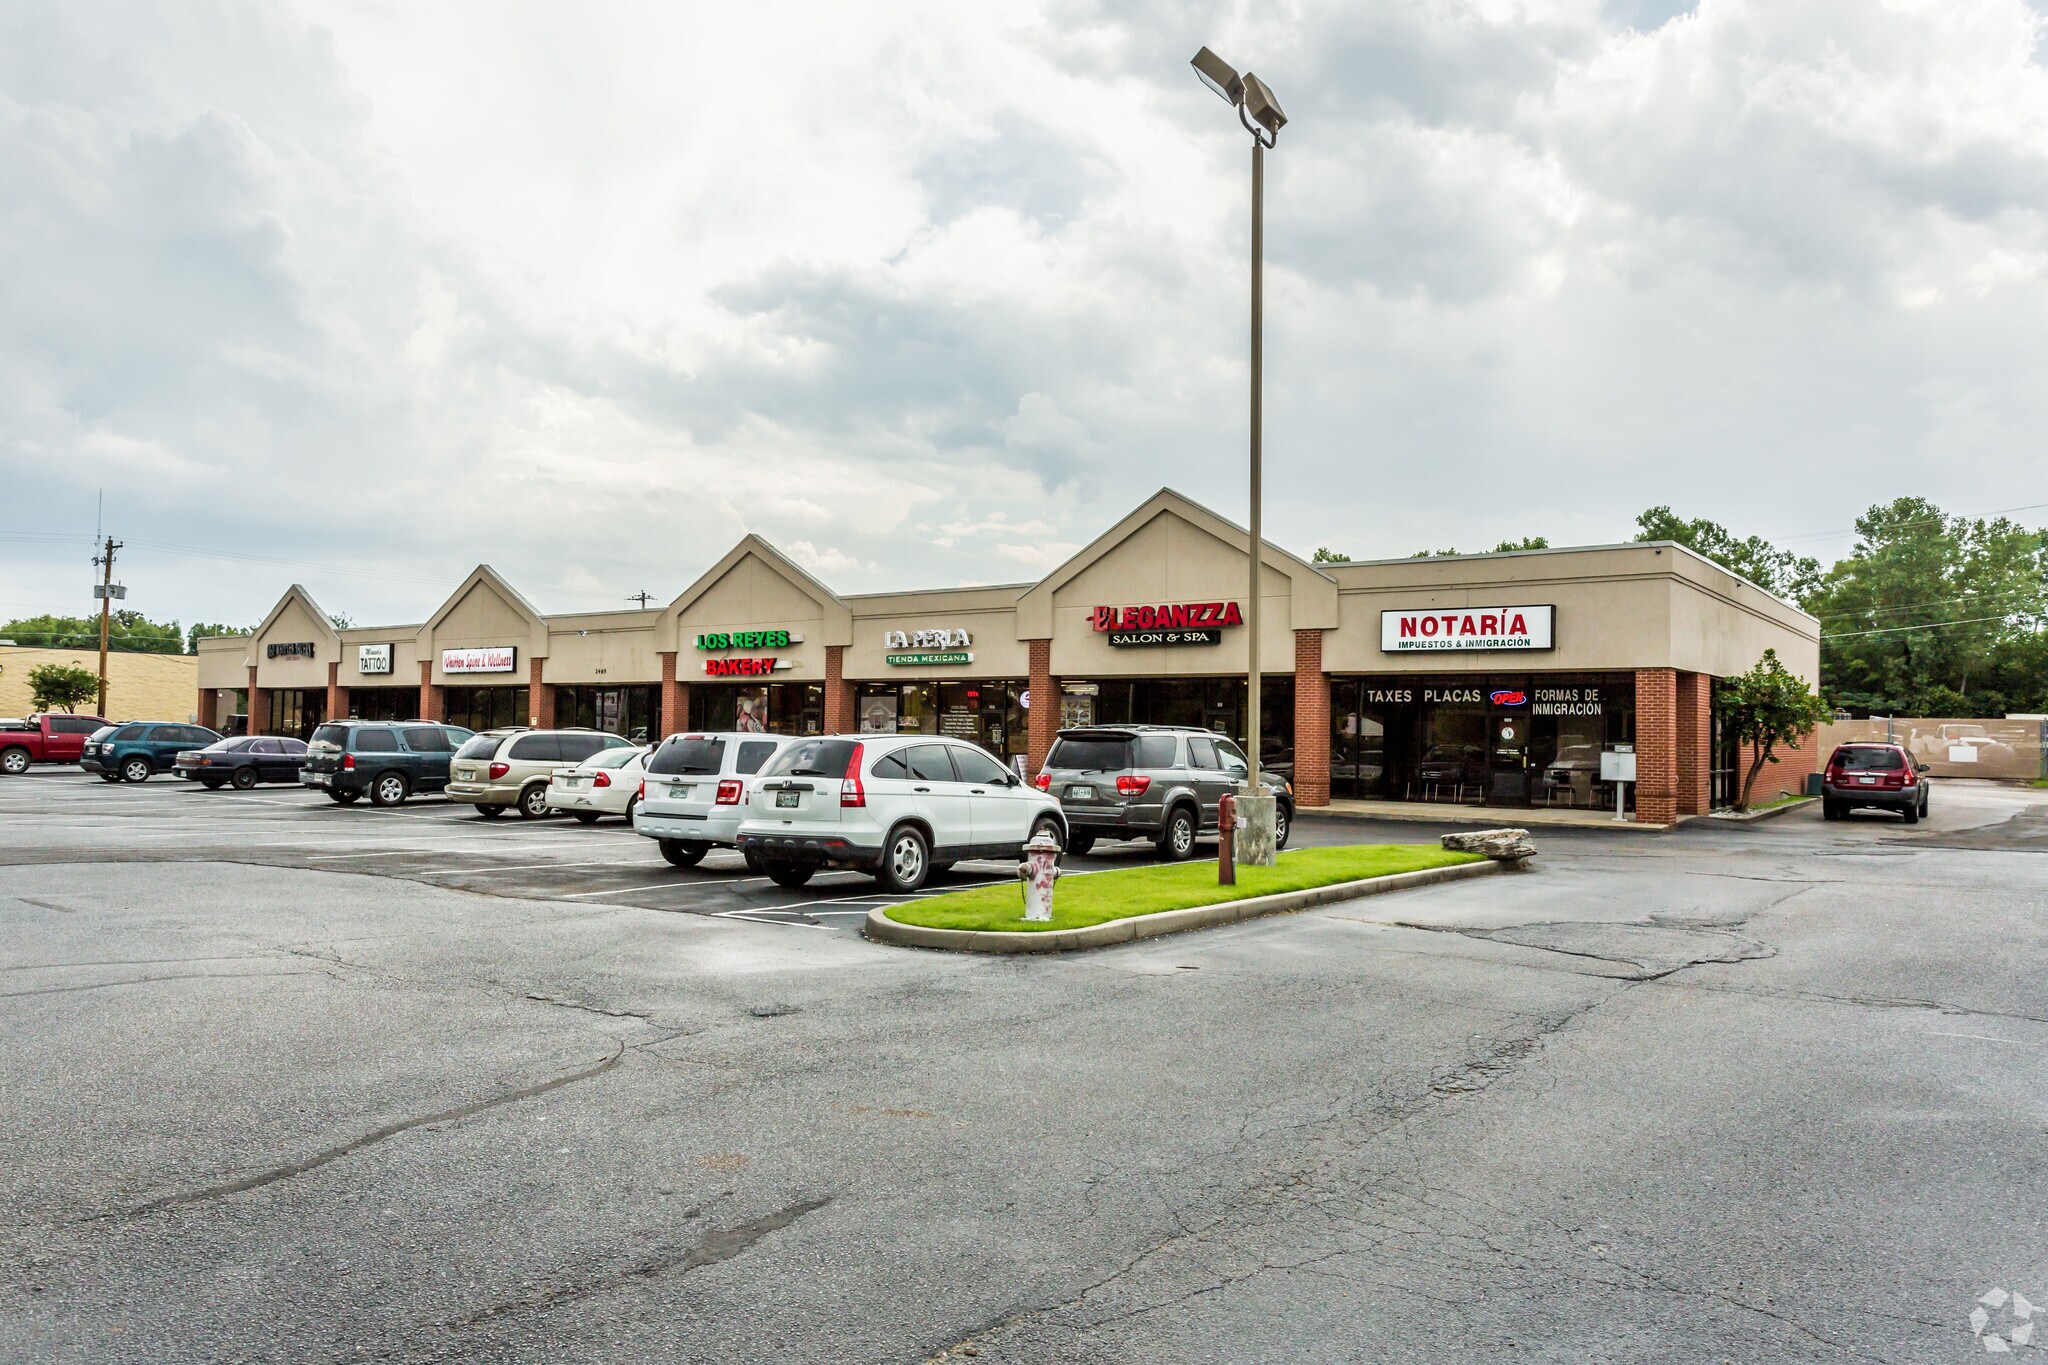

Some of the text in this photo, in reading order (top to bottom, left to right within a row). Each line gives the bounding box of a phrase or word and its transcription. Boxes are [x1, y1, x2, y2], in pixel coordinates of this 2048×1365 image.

[1086, 602, 1242, 632] ELEGANZZA
[1400, 609, 1528, 637] NOTARÍA
[698, 630, 790, 650] LOS REYES
[884, 629, 970, 650] LA PERLA
[1112, 632, 1210, 644] SALON & SPA
[1398, 636, 1531, 649] IMPUESTOS & INMIGRACIÓN
[360, 657, 387, 670] TATTOO
[922, 654, 967, 662] MEXICANA
[706, 658, 776, 675] BAKERY
[1367, 690, 1481, 702] TAXES PLACAS
[1493, 691, 1524, 705] OPEN
[1535, 689, 1599, 701] FORMAS DE
[1532, 701, 1602, 716] INMIGRACIÓN
